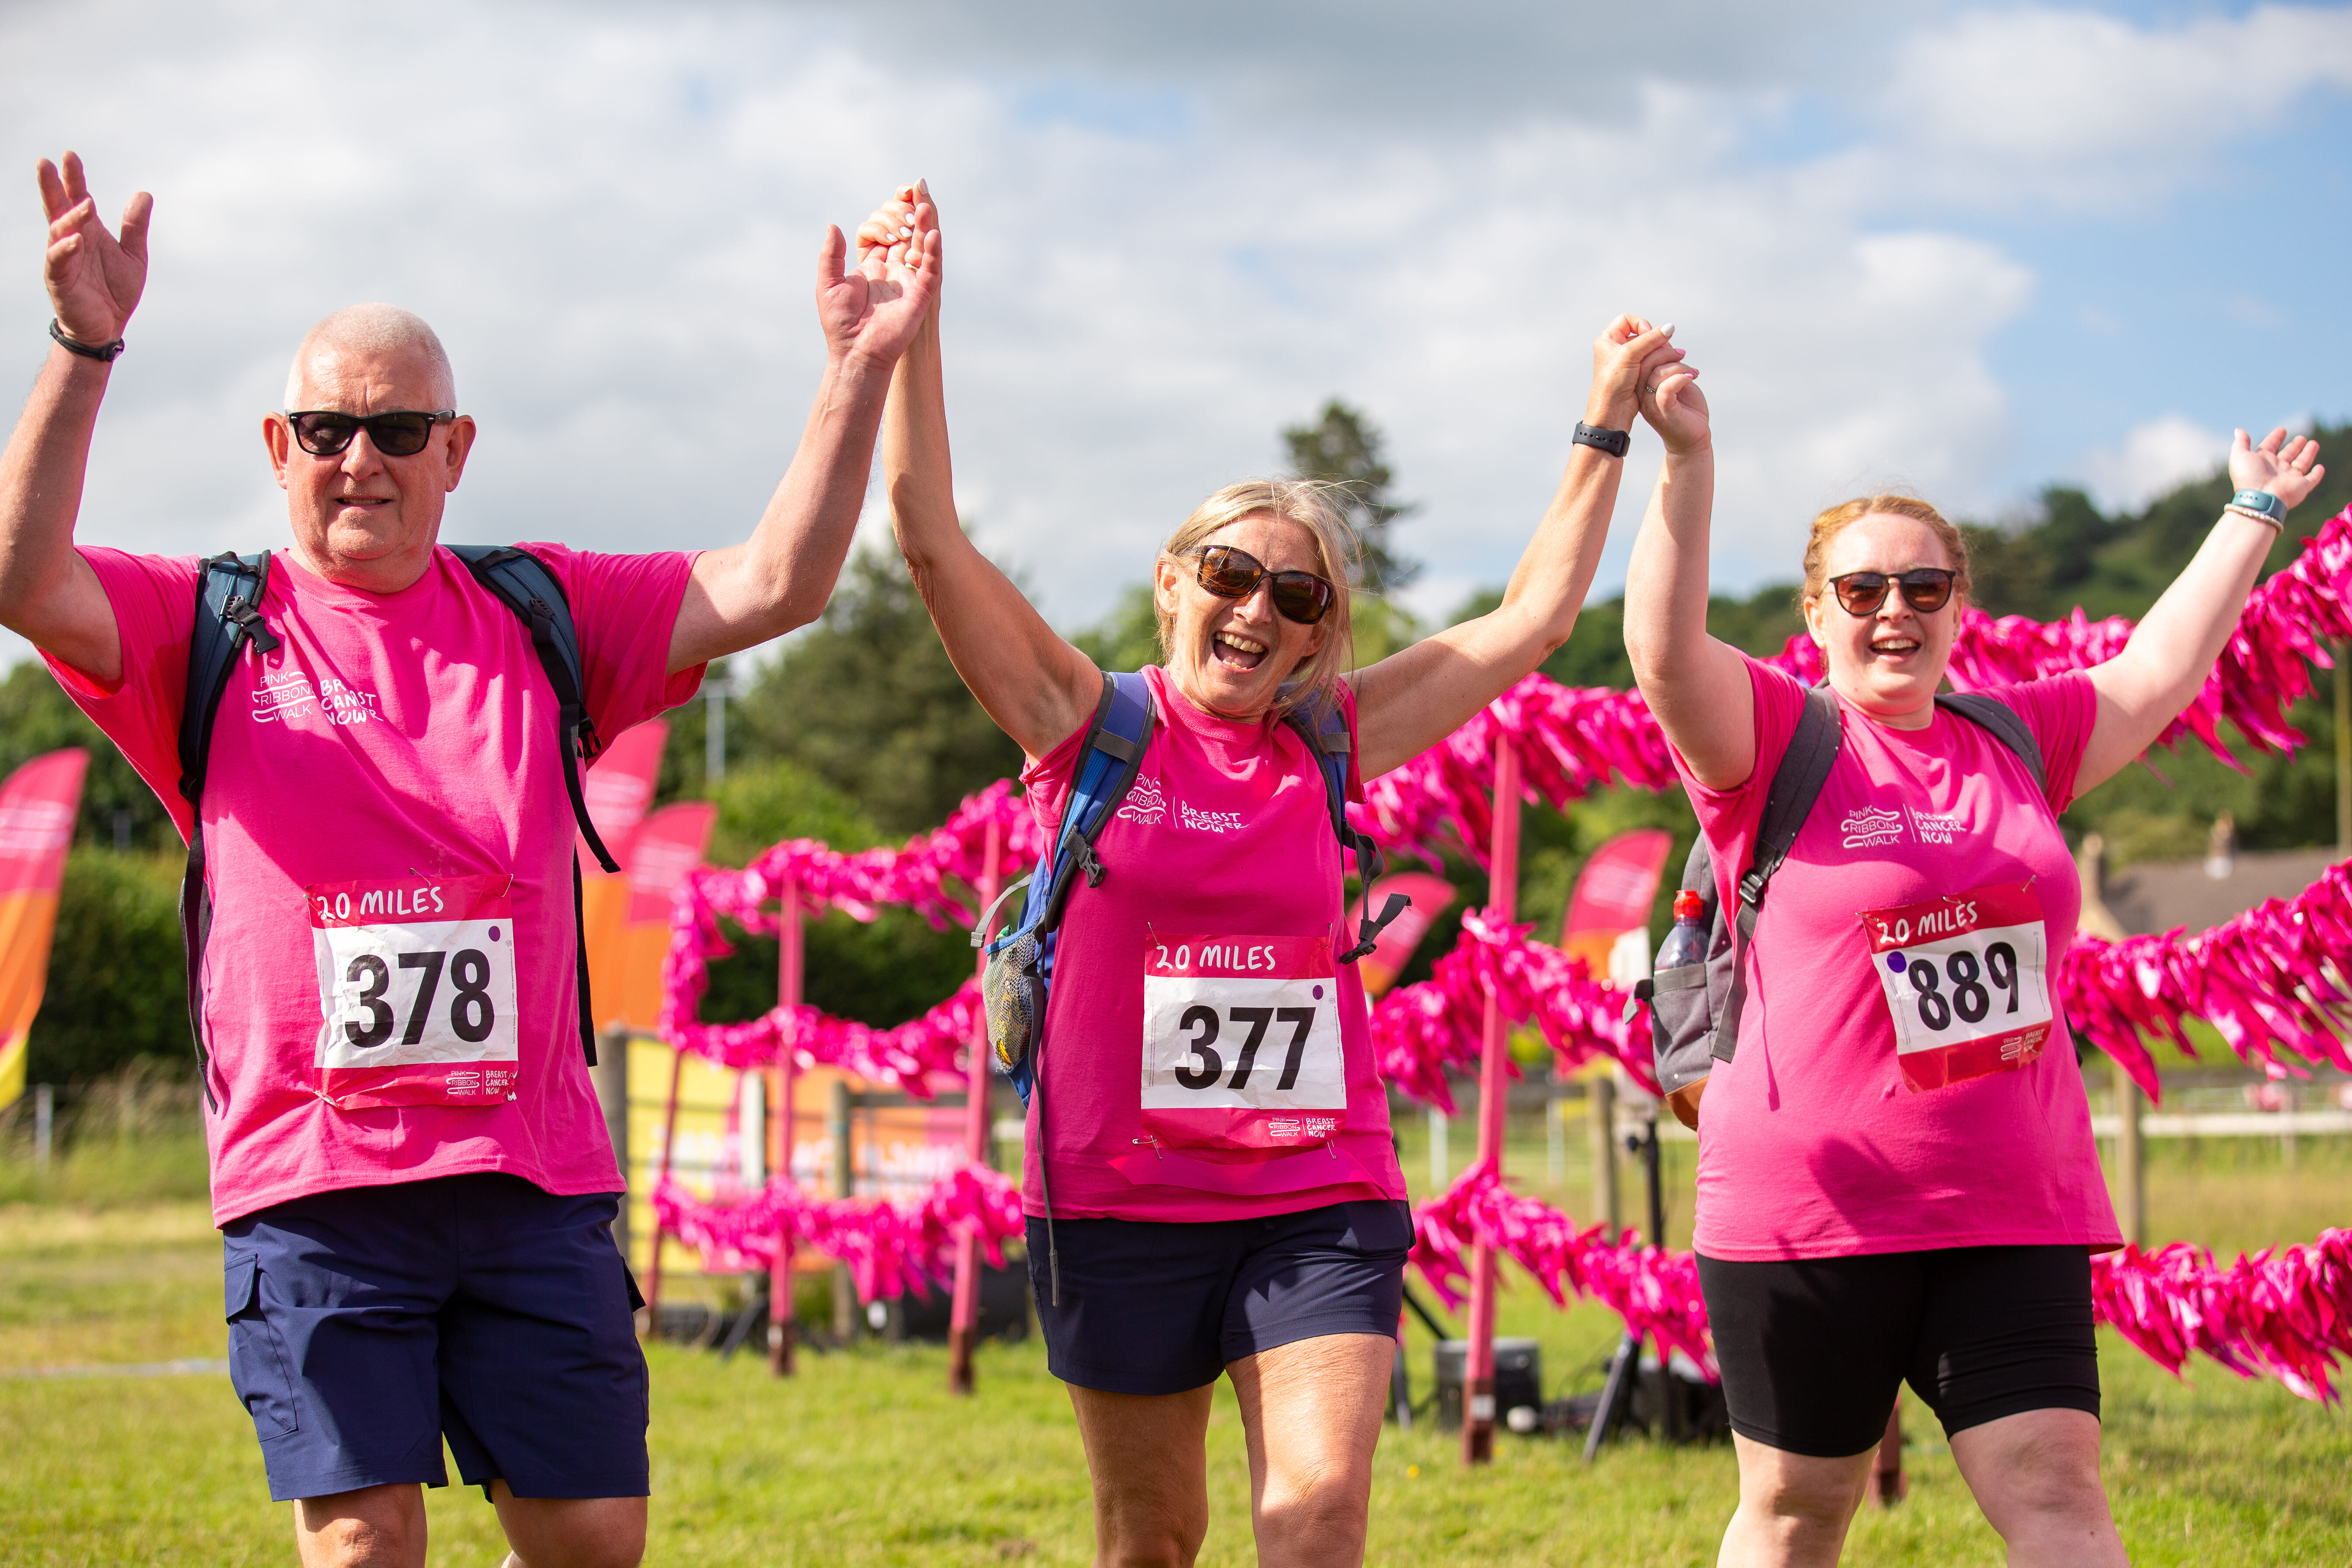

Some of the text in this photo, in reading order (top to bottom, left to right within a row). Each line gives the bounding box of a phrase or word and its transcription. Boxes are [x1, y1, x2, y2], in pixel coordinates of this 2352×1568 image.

[260, 671, 288, 687] PINK
[261, 685, 310, 706] RIBBON
[273, 703, 312, 721] WALK
[1132, 811, 1163, 825] WALK
[1181, 800, 1241, 822] BREAST
[1849, 805, 1873, 819] PINK
[1184, 819, 1224, 833] NOW
[1850, 820, 1895, 833] RIBBON
[1915, 819, 1967, 832] CANCER
[1863, 835, 1900, 847] WALK
[1920, 830, 1953, 845] NOW
[316, 886, 444, 920] 20 MILES
[1877, 901, 1978, 944] 20 MILES
[1156, 945, 1276, 971] 20 MILES
[1908, 941, 2019, 1031] 889
[344, 949, 495, 1048] 378
[1175, 1005, 1316, 1090] 377
[486, 1070, 508, 1079] BREAST
